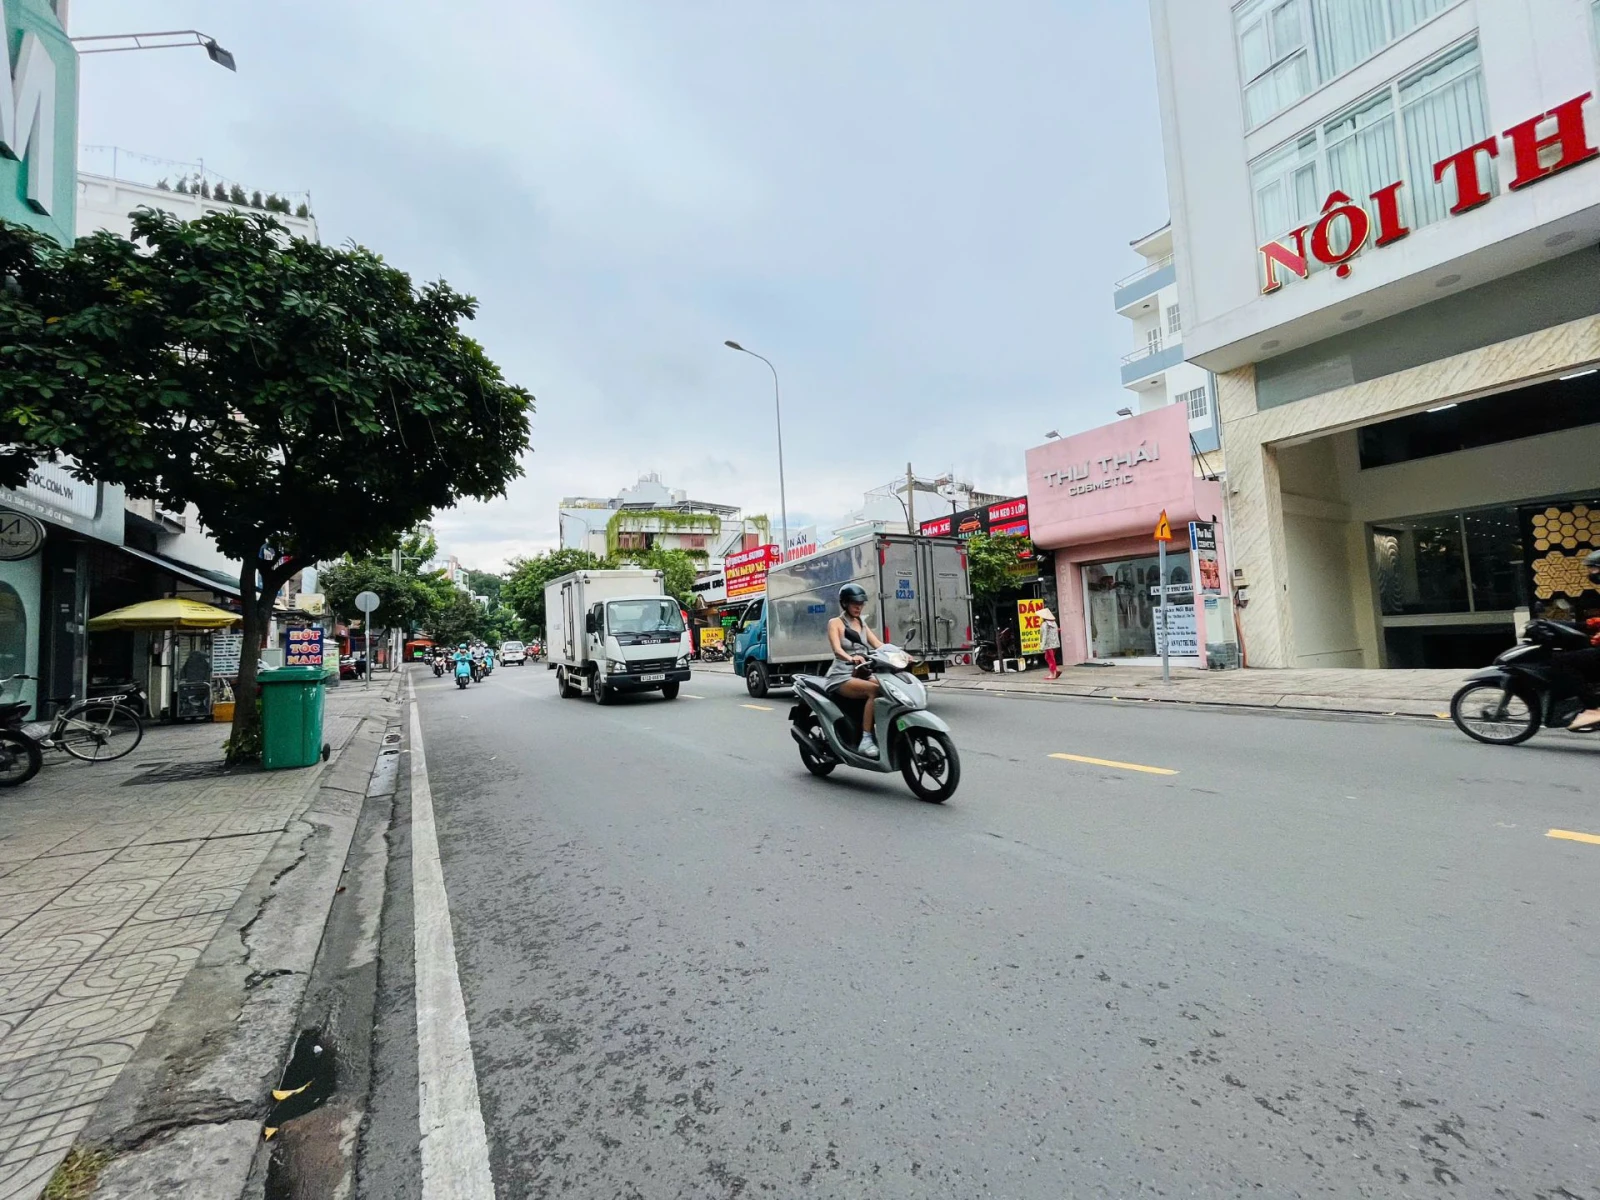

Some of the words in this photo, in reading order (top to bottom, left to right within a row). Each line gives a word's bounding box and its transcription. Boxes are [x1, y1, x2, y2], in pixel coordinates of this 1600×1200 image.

[1258, 180, 1409, 294] NỘI
[1044, 460, 1090, 488] THƯ
[1098, 440, 1160, 474] THÁI
[1068, 475, 1134, 497] COSMETIC
[1011, 506, 1015, 515] 3
[1015, 502, 1026, 515] LỚP
[922, 522, 938, 537] DÁN
[940, 521, 951, 532] XE
[1019, 601, 1044, 614] DÁN
[1024, 615, 1041, 629] XE
[289, 628, 321, 641] HỚT
[290, 642, 320, 653] TÓC
[287, 655, 322, 665] NAM
